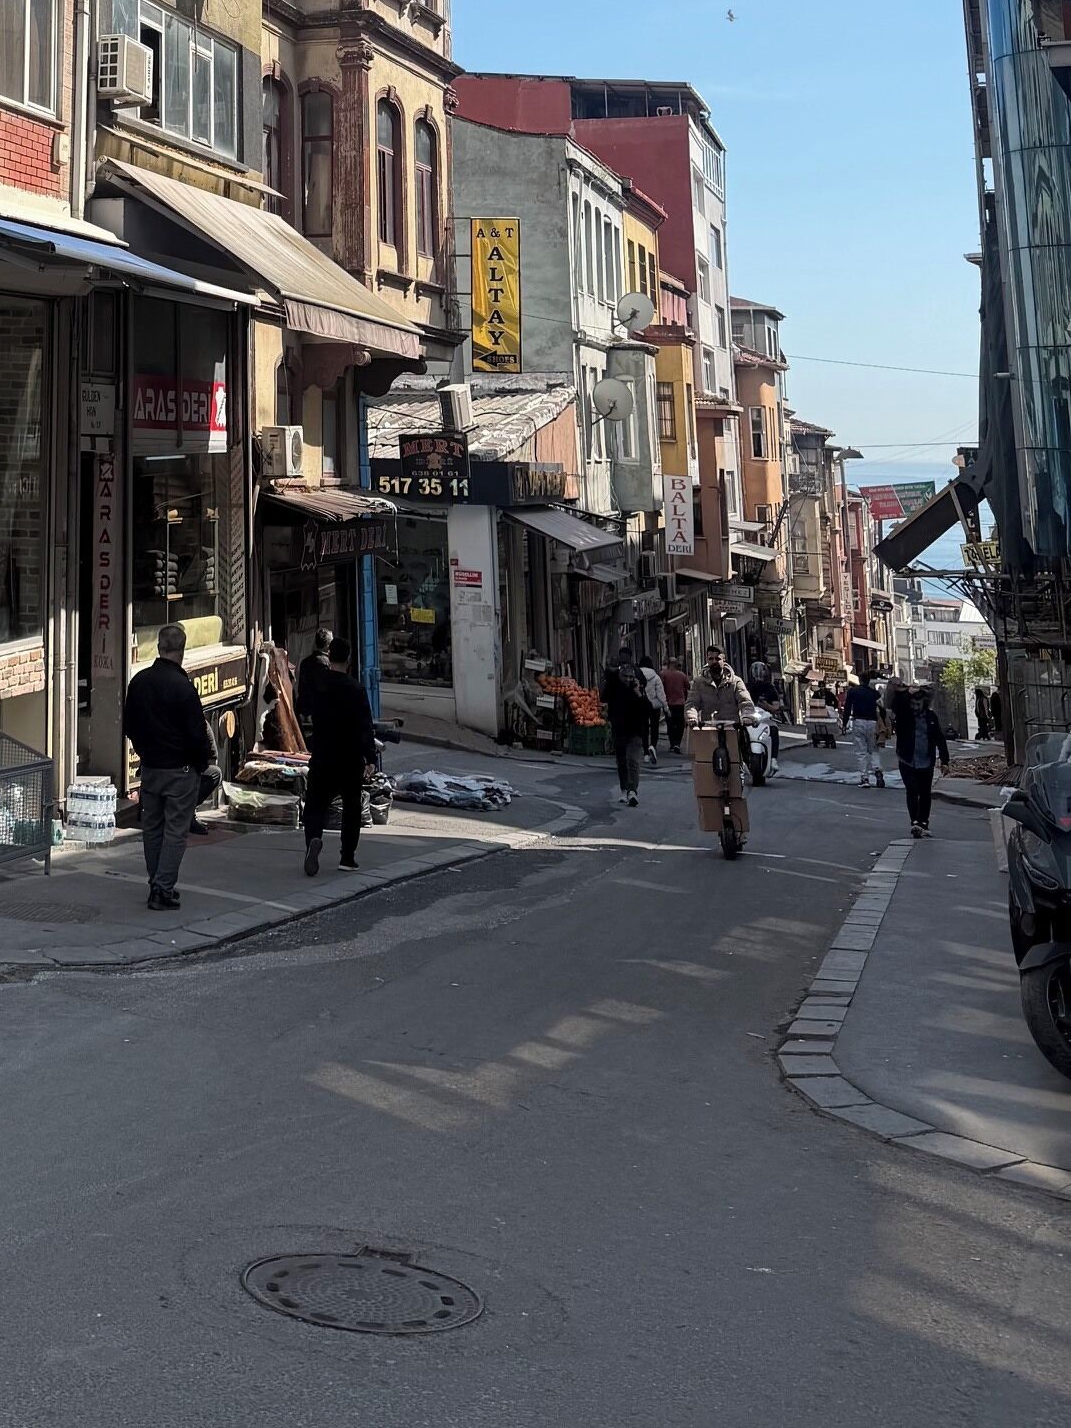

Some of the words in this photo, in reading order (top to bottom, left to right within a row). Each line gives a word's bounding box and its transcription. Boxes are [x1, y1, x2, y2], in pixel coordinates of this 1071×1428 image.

[476, 227, 485, 238] A
[490, 227, 500, 238] &
[505, 227, 514, 238] T
[487, 246, 505, 346] ALTAY
[133, 387, 176, 422] ARAS
[403, 437, 465, 458] MERT
[379, 476, 412, 495] 517
[418, 477, 443, 496] 35
[449, 478, 470, 497] 11
[98, 482, 113, 568] ARAS
[671, 478, 687, 543] BALTA
[321, 528, 357, 555] MERT
